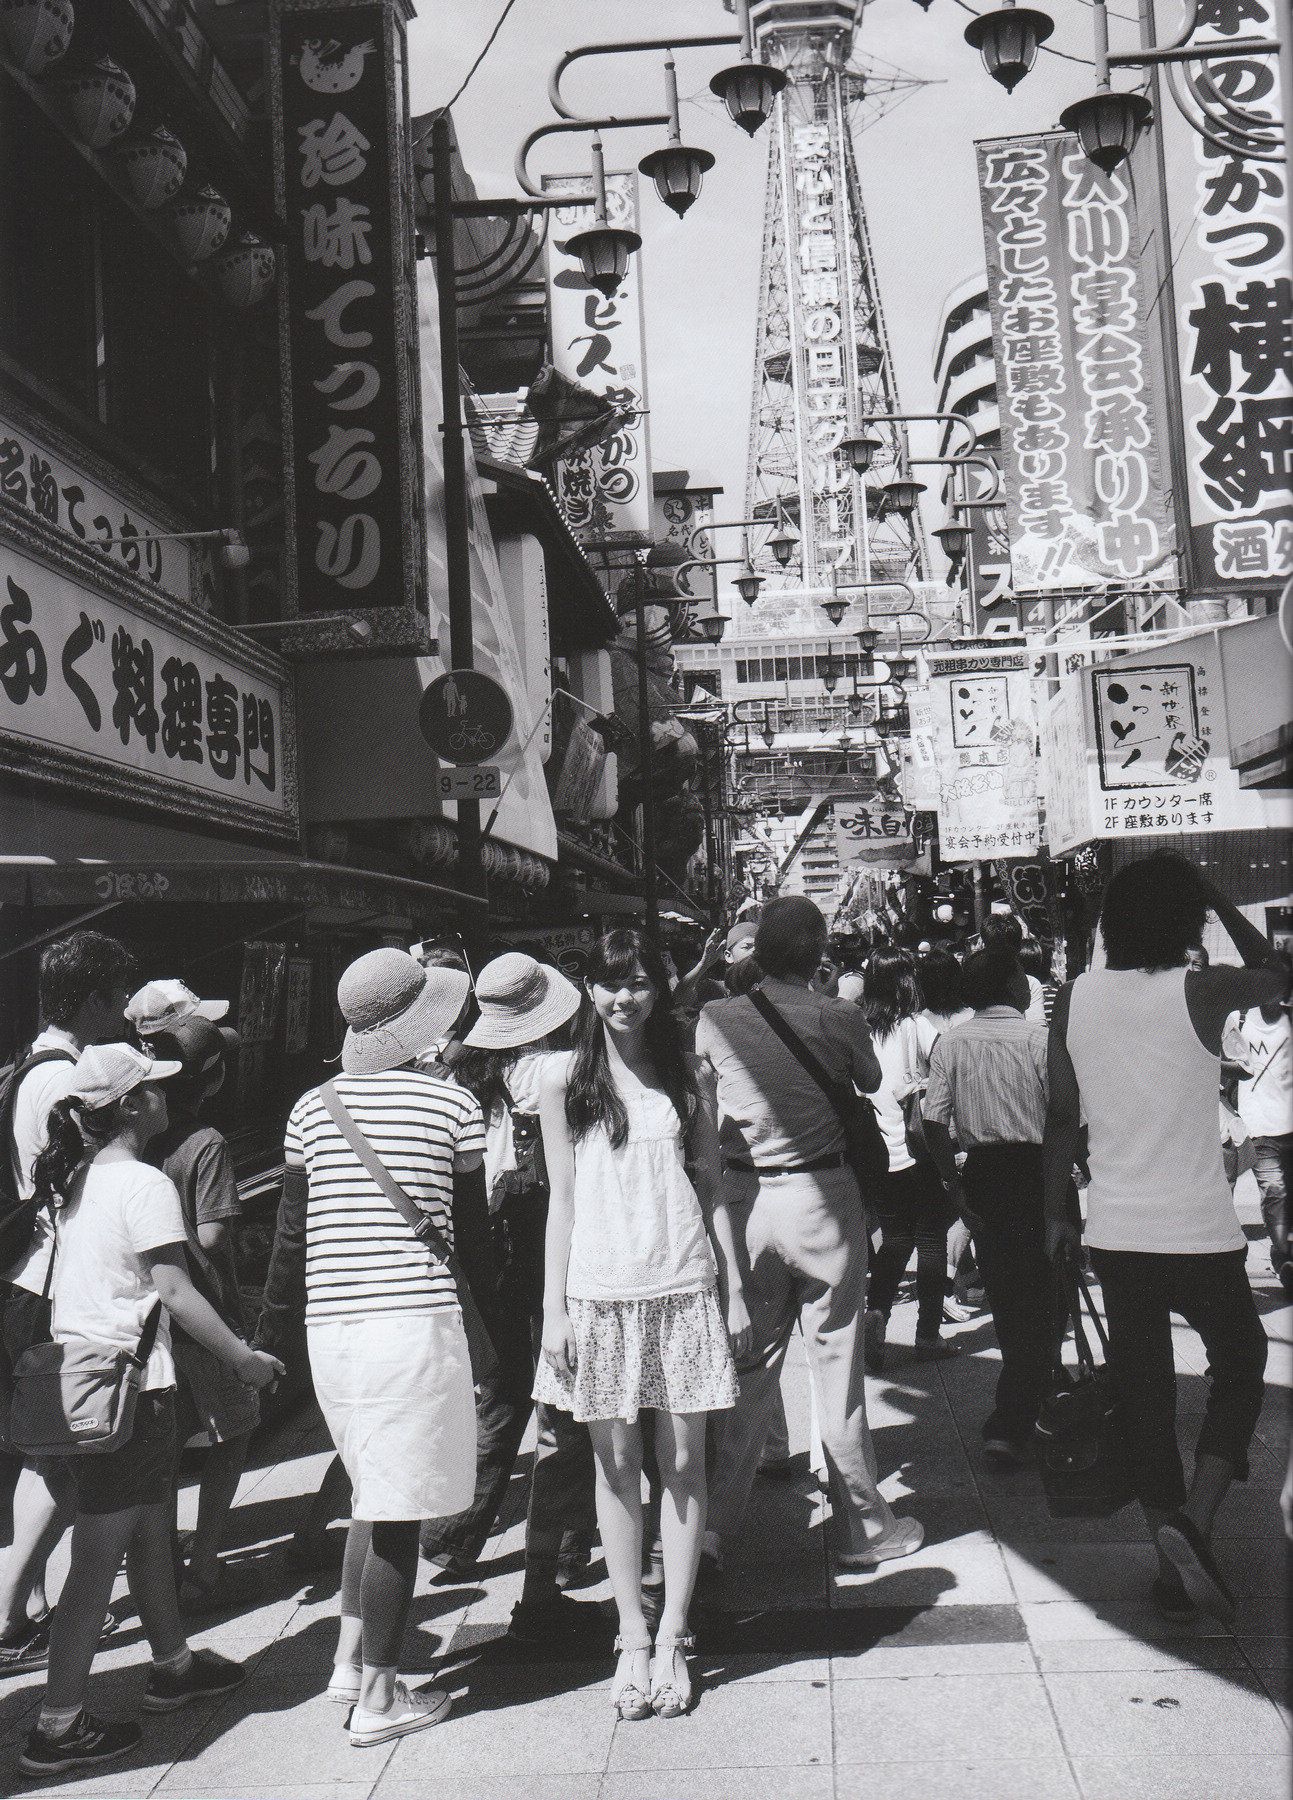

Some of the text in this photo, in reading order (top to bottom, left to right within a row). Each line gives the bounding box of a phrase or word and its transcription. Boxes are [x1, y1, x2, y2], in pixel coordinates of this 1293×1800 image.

[933, 656, 1025, 672] 元祖串カツ専門店
[1160, 682, 1184, 730] 新世界
[1104, 792, 1214, 811] 1F カウンター席
[840, 807, 911, 839] 味自
[1104, 810, 1215, 830] 2F 座敷あります
[944, 830, 1037, 850] 宴会予約受付中
